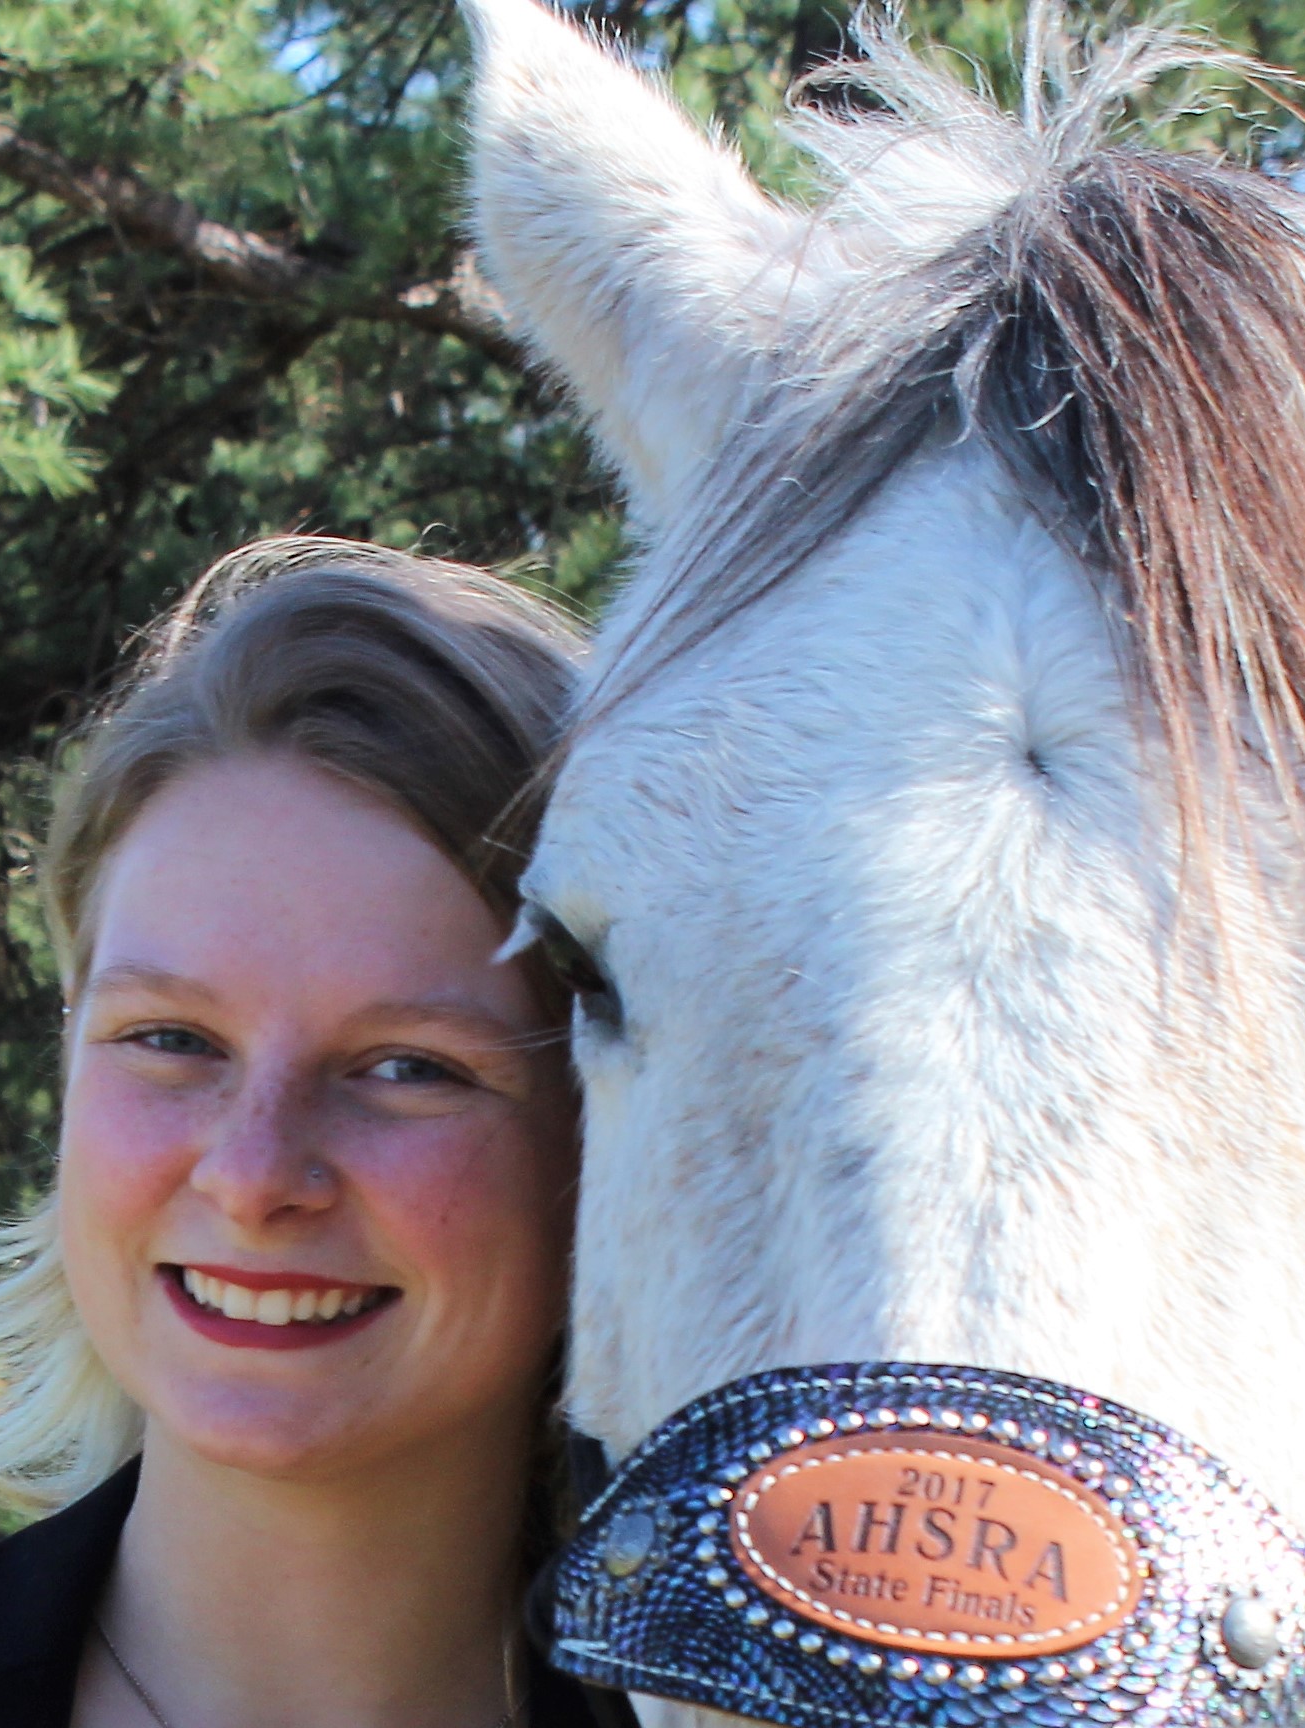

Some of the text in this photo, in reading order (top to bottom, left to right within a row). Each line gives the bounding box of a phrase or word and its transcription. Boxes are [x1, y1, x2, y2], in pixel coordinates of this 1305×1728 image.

[898, 1467, 997, 1507] 2017
[790, 1501, 1068, 1602] AHSRA
[810, 1559, 1036, 1627] State Finals
